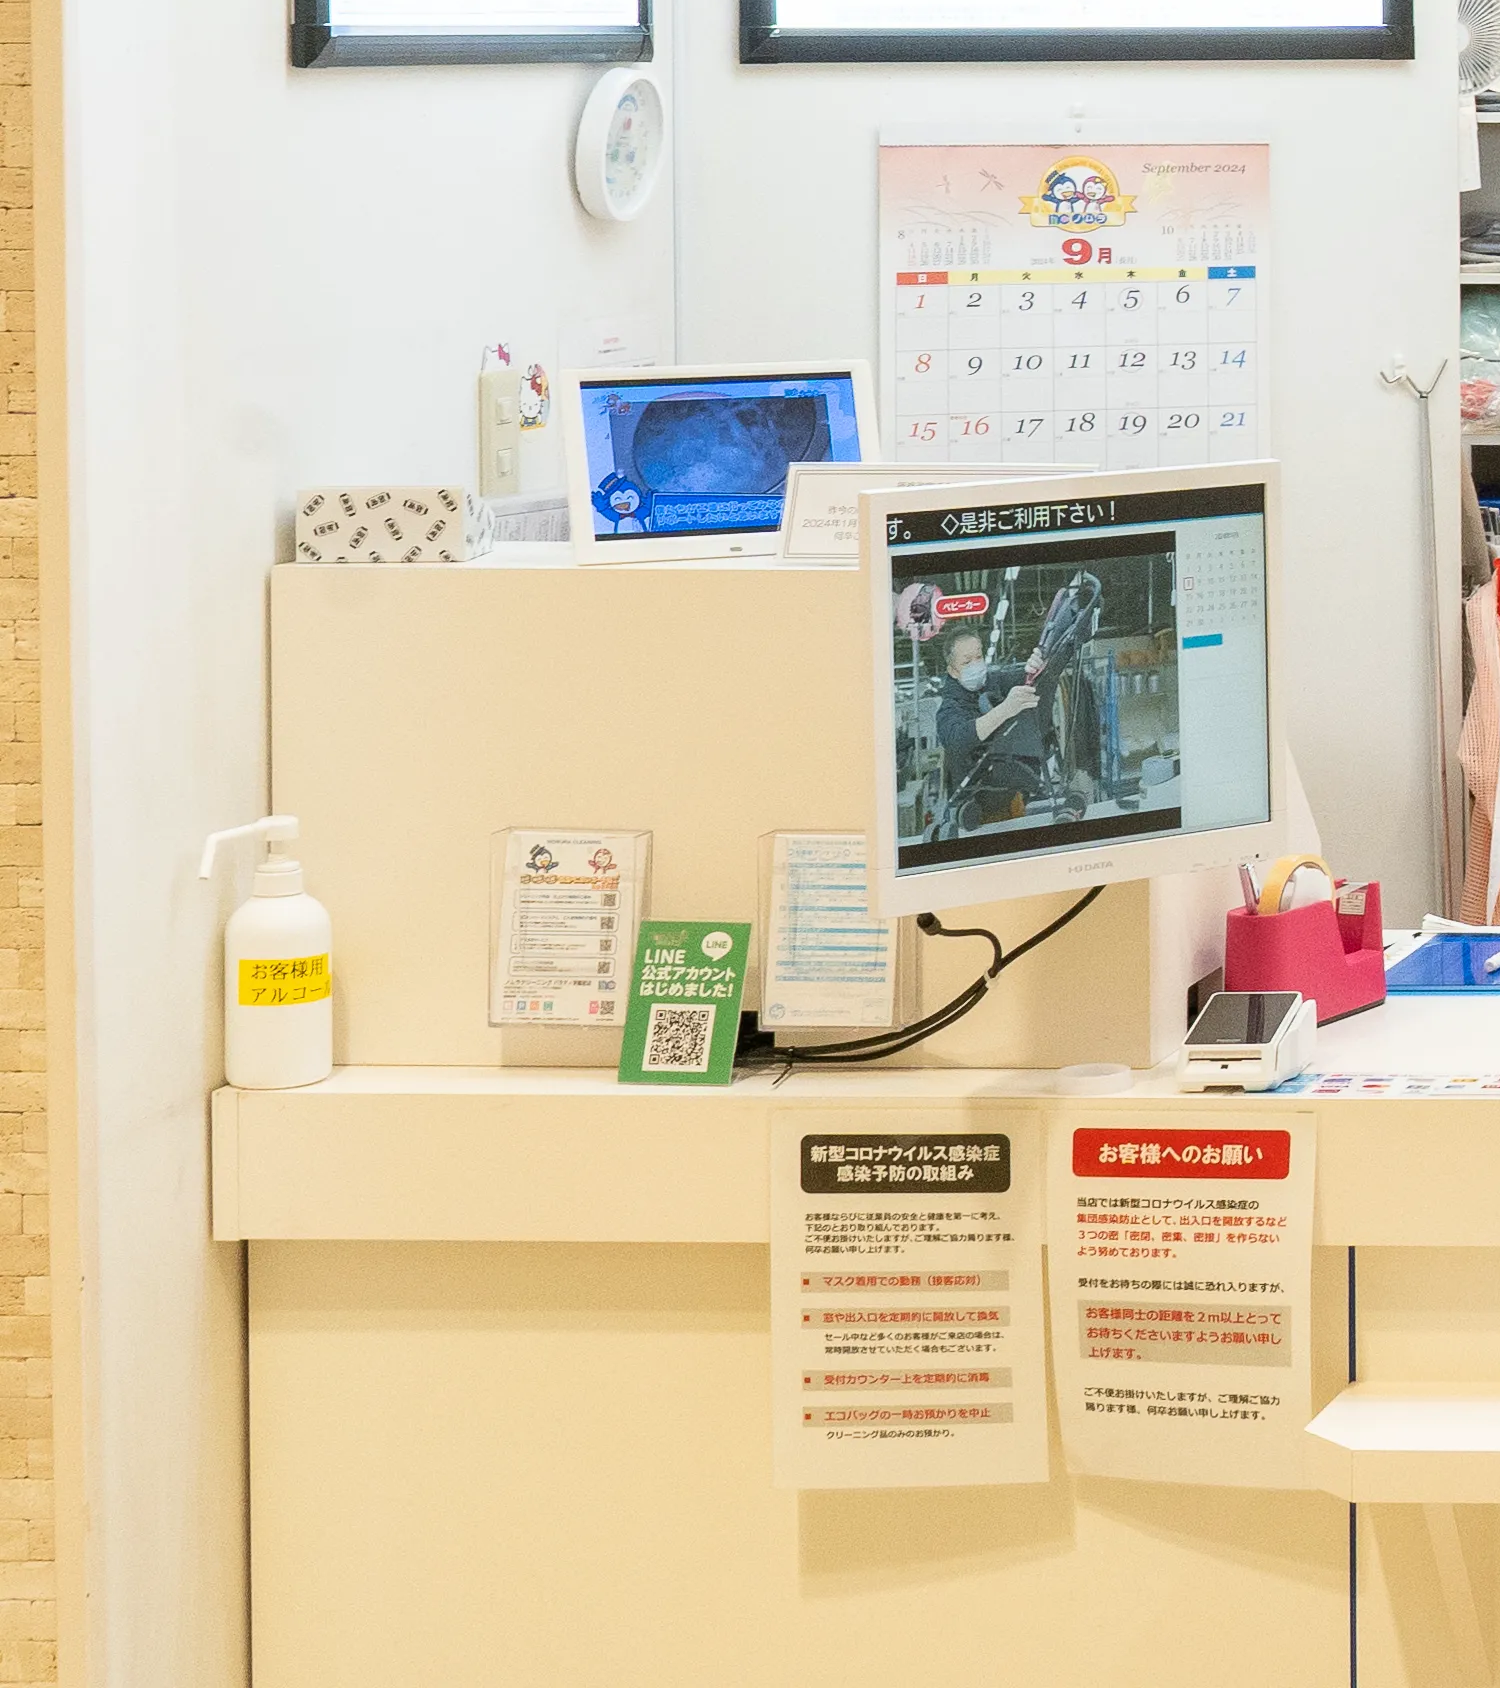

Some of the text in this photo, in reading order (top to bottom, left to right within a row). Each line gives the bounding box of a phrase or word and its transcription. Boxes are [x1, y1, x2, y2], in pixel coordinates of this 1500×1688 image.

[1141, 161, 1246, 176] September 2024
[914, 285, 1241, 311] 1 2 3 4 5 6 7
[914, 349, 1247, 376] 8 9 10 11 12 13 14
[908, 411, 1246, 442] 15 16 17 18 19 20 21
[706, 939, 728, 948] LINE
[644, 949, 687, 964] LINE
[641, 966, 736, 982] 公式アカウント
[810, 1145, 1001, 1162] 新型コロナウイルス感染症
[1099, 1143, 1263, 1165] お客様へのお願い
[837, 1165, 974, 1182] 感染予防の取組み
[1076, 1197, 1259, 1210] 当店では新型コロナウイルス感染症の
